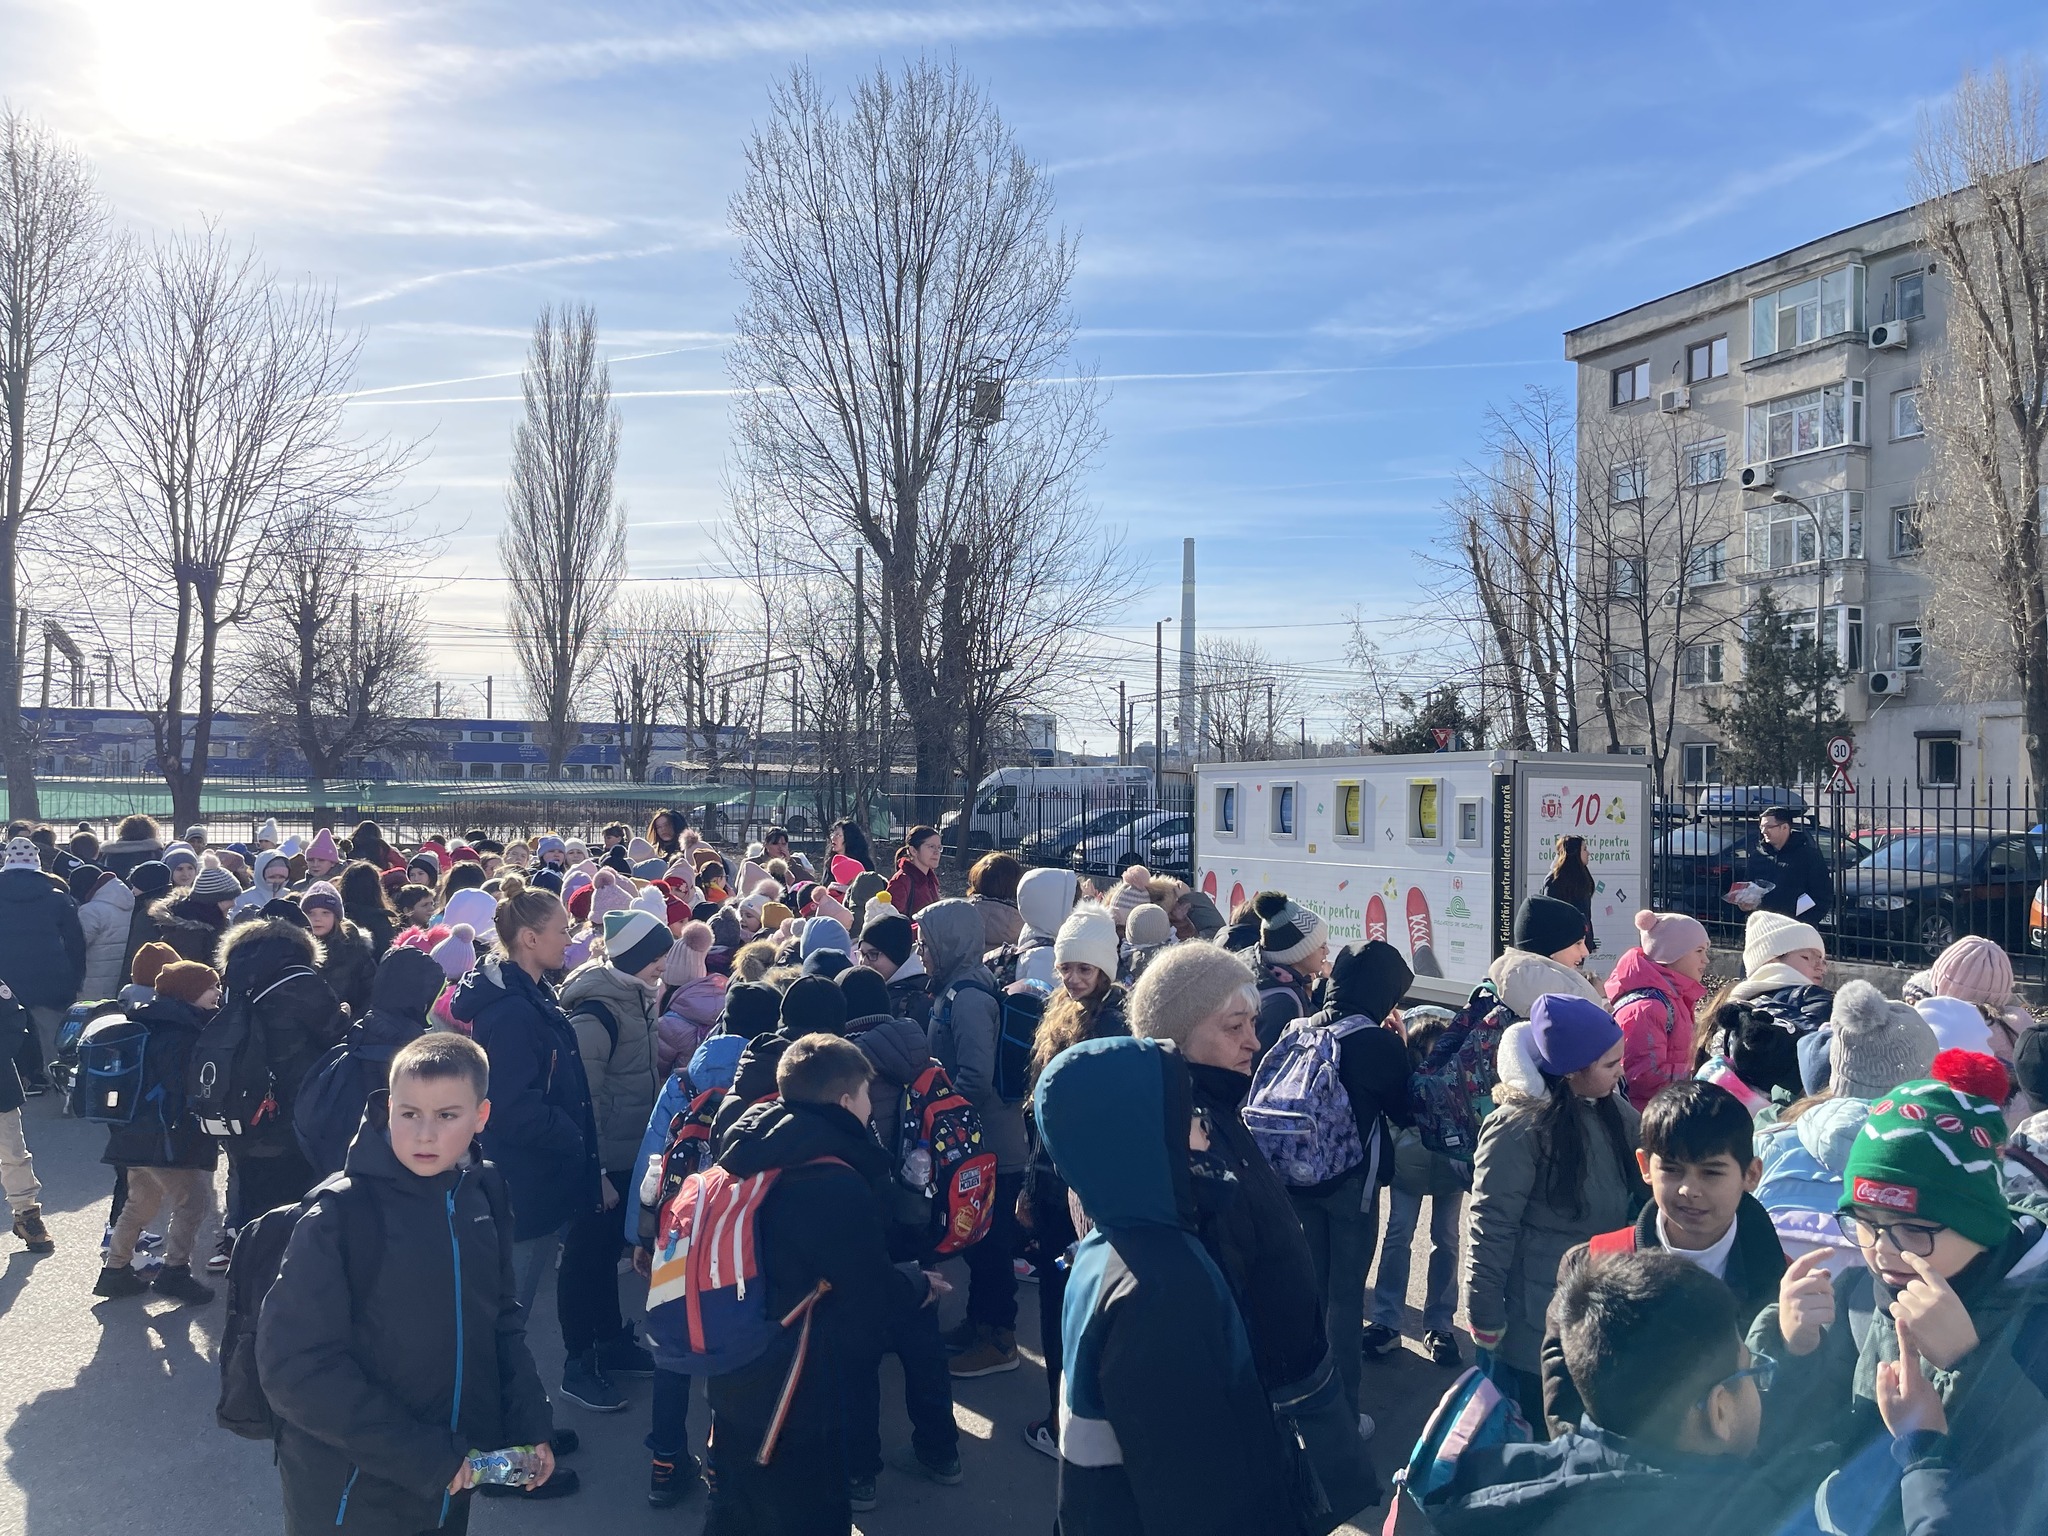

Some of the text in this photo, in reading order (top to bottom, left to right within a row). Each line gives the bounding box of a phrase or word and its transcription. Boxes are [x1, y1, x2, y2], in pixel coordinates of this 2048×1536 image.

[600, 745, 606, 753] 2
[1834, 744, 1846, 758] 30
[1501, 784, 1513, 823] separată
[1571, 793, 1601, 827] 10
[1500, 825, 1510, 869] colectarea
[1540, 837, 1550, 846] cu
[1600, 836, 1629, 850] pentru
[1590, 850, 1631, 864] separată
[1501, 872, 1512, 900] pentru
[1328, 904, 1361, 921] pentru
[1500, 902, 1510, 942] Felicitări
[1328, 924, 1362, 939] parată
